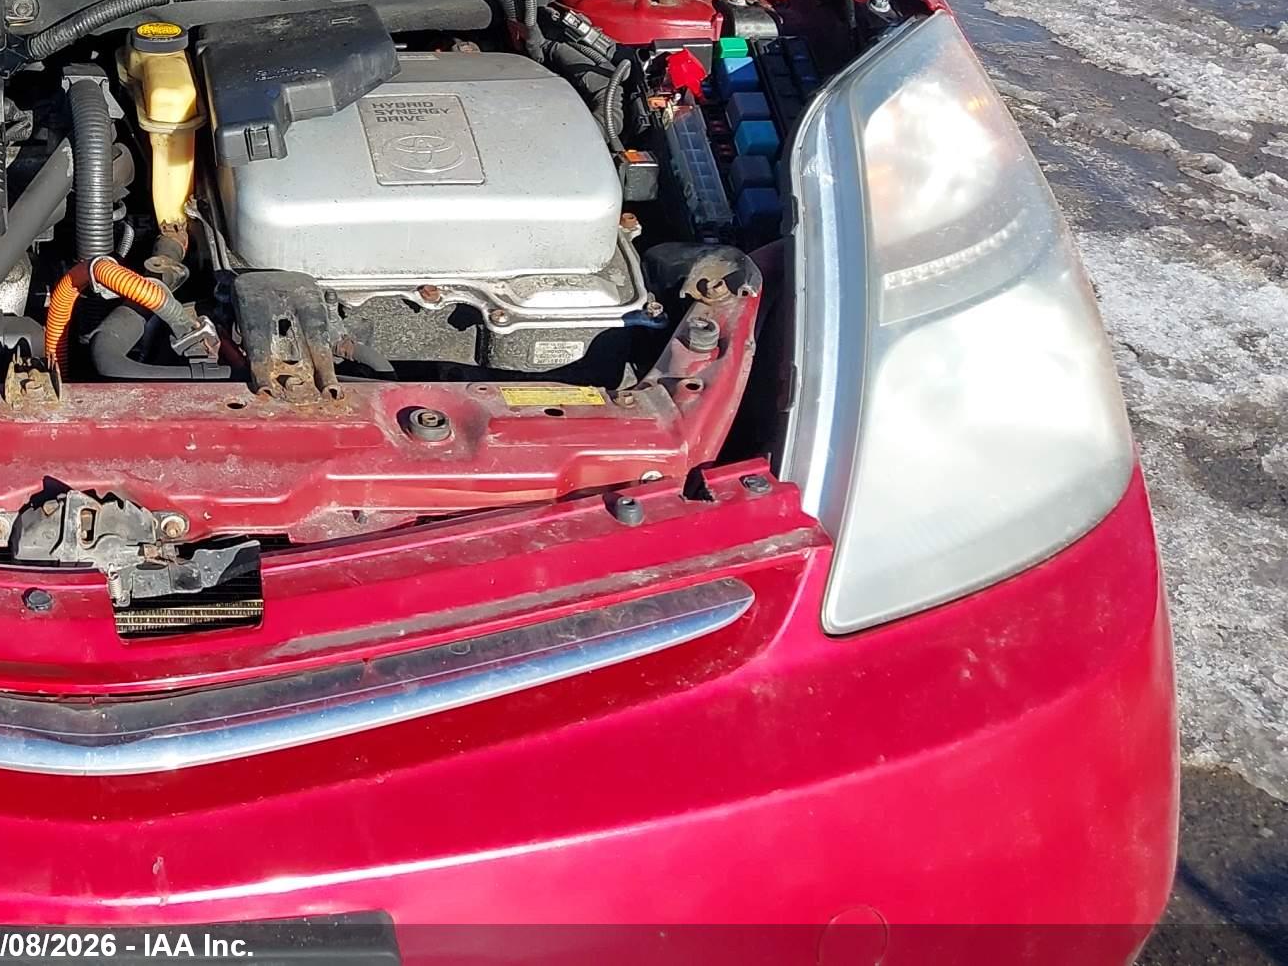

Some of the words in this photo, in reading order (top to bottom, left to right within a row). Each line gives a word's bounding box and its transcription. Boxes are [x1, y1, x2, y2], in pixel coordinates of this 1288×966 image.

[371, 101, 434, 109] HYBRID
[374, 107, 450, 116] SYNERGY
[376, 115, 426, 123] DRIVE
